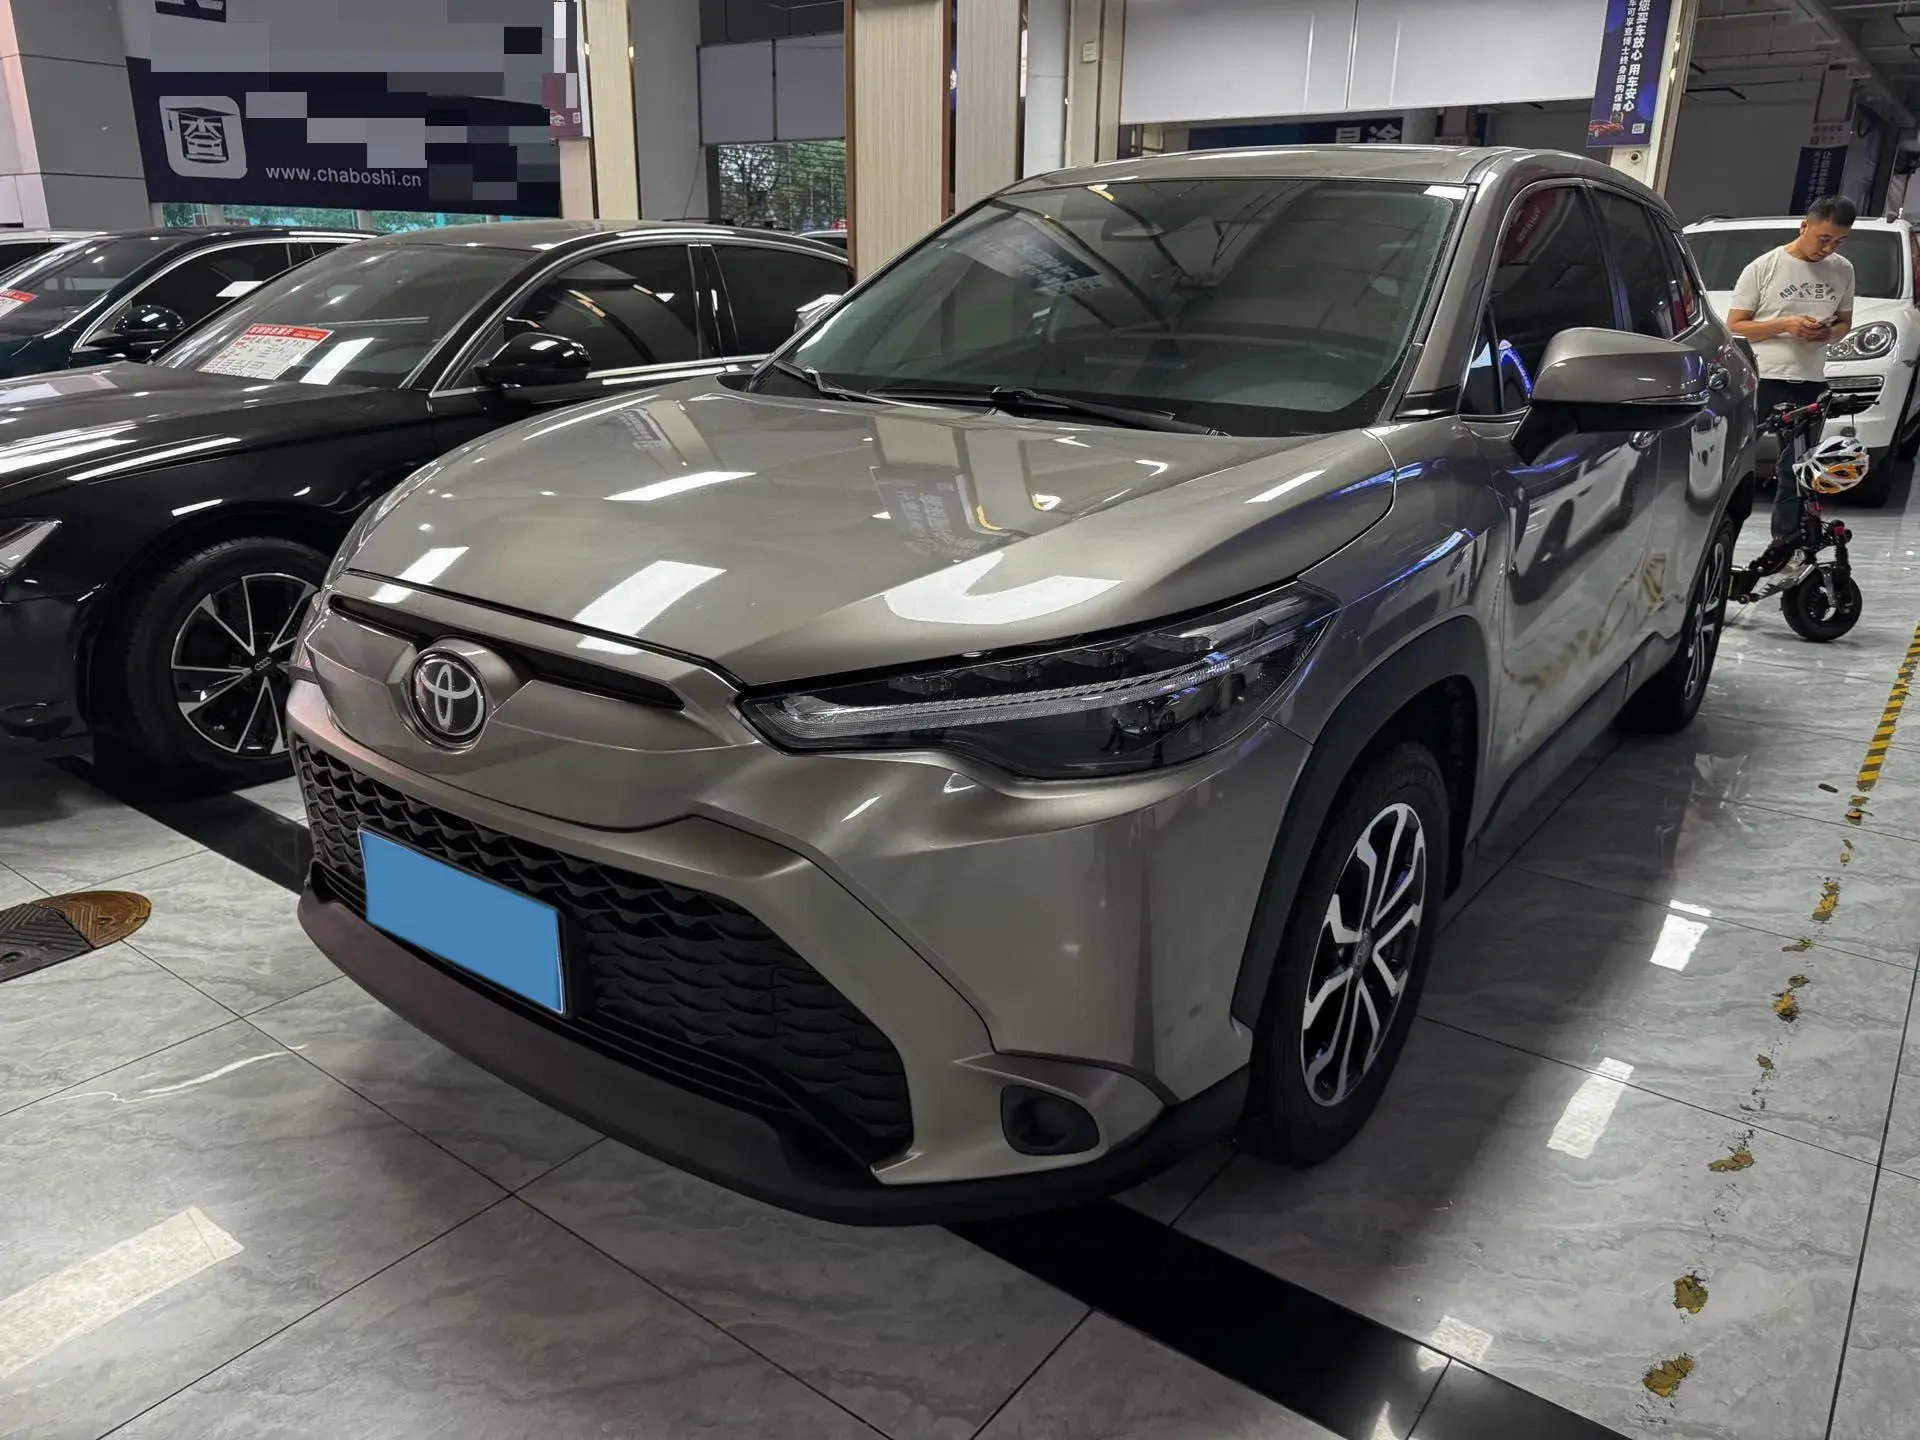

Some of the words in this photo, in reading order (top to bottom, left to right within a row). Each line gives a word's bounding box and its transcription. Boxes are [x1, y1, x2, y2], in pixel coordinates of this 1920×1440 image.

[1623, 64, 1641, 112] 用车安心
[265, 167, 422, 187] www.chaboshi.cn
